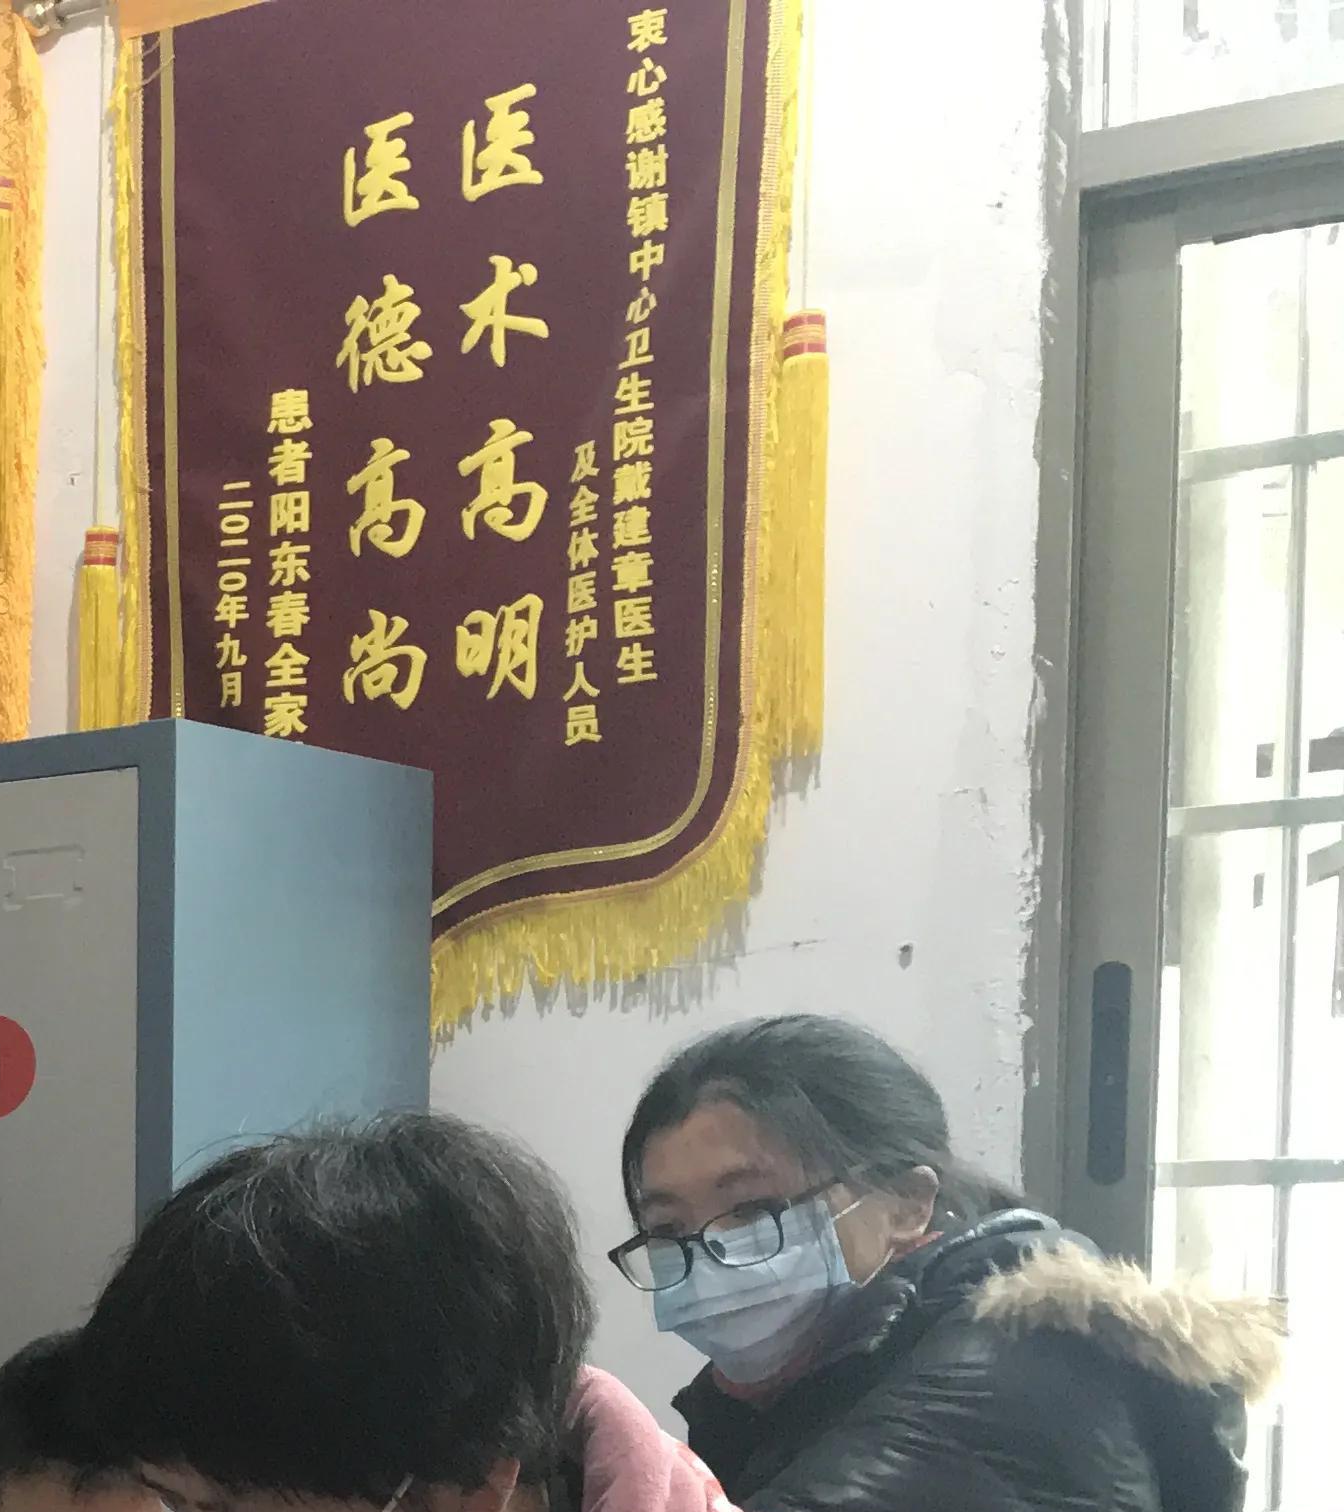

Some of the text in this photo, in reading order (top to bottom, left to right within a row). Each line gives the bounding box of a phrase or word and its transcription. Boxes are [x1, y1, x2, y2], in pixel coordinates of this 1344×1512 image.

[336, 111, 434, 710] 医德高尚
[456, 83, 550, 700] 医术高明
[563, 440, 603, 747] 及全体医护人员
[611, 8, 669, 684] 衷心感谢镇中心卫生院戴建章医生
